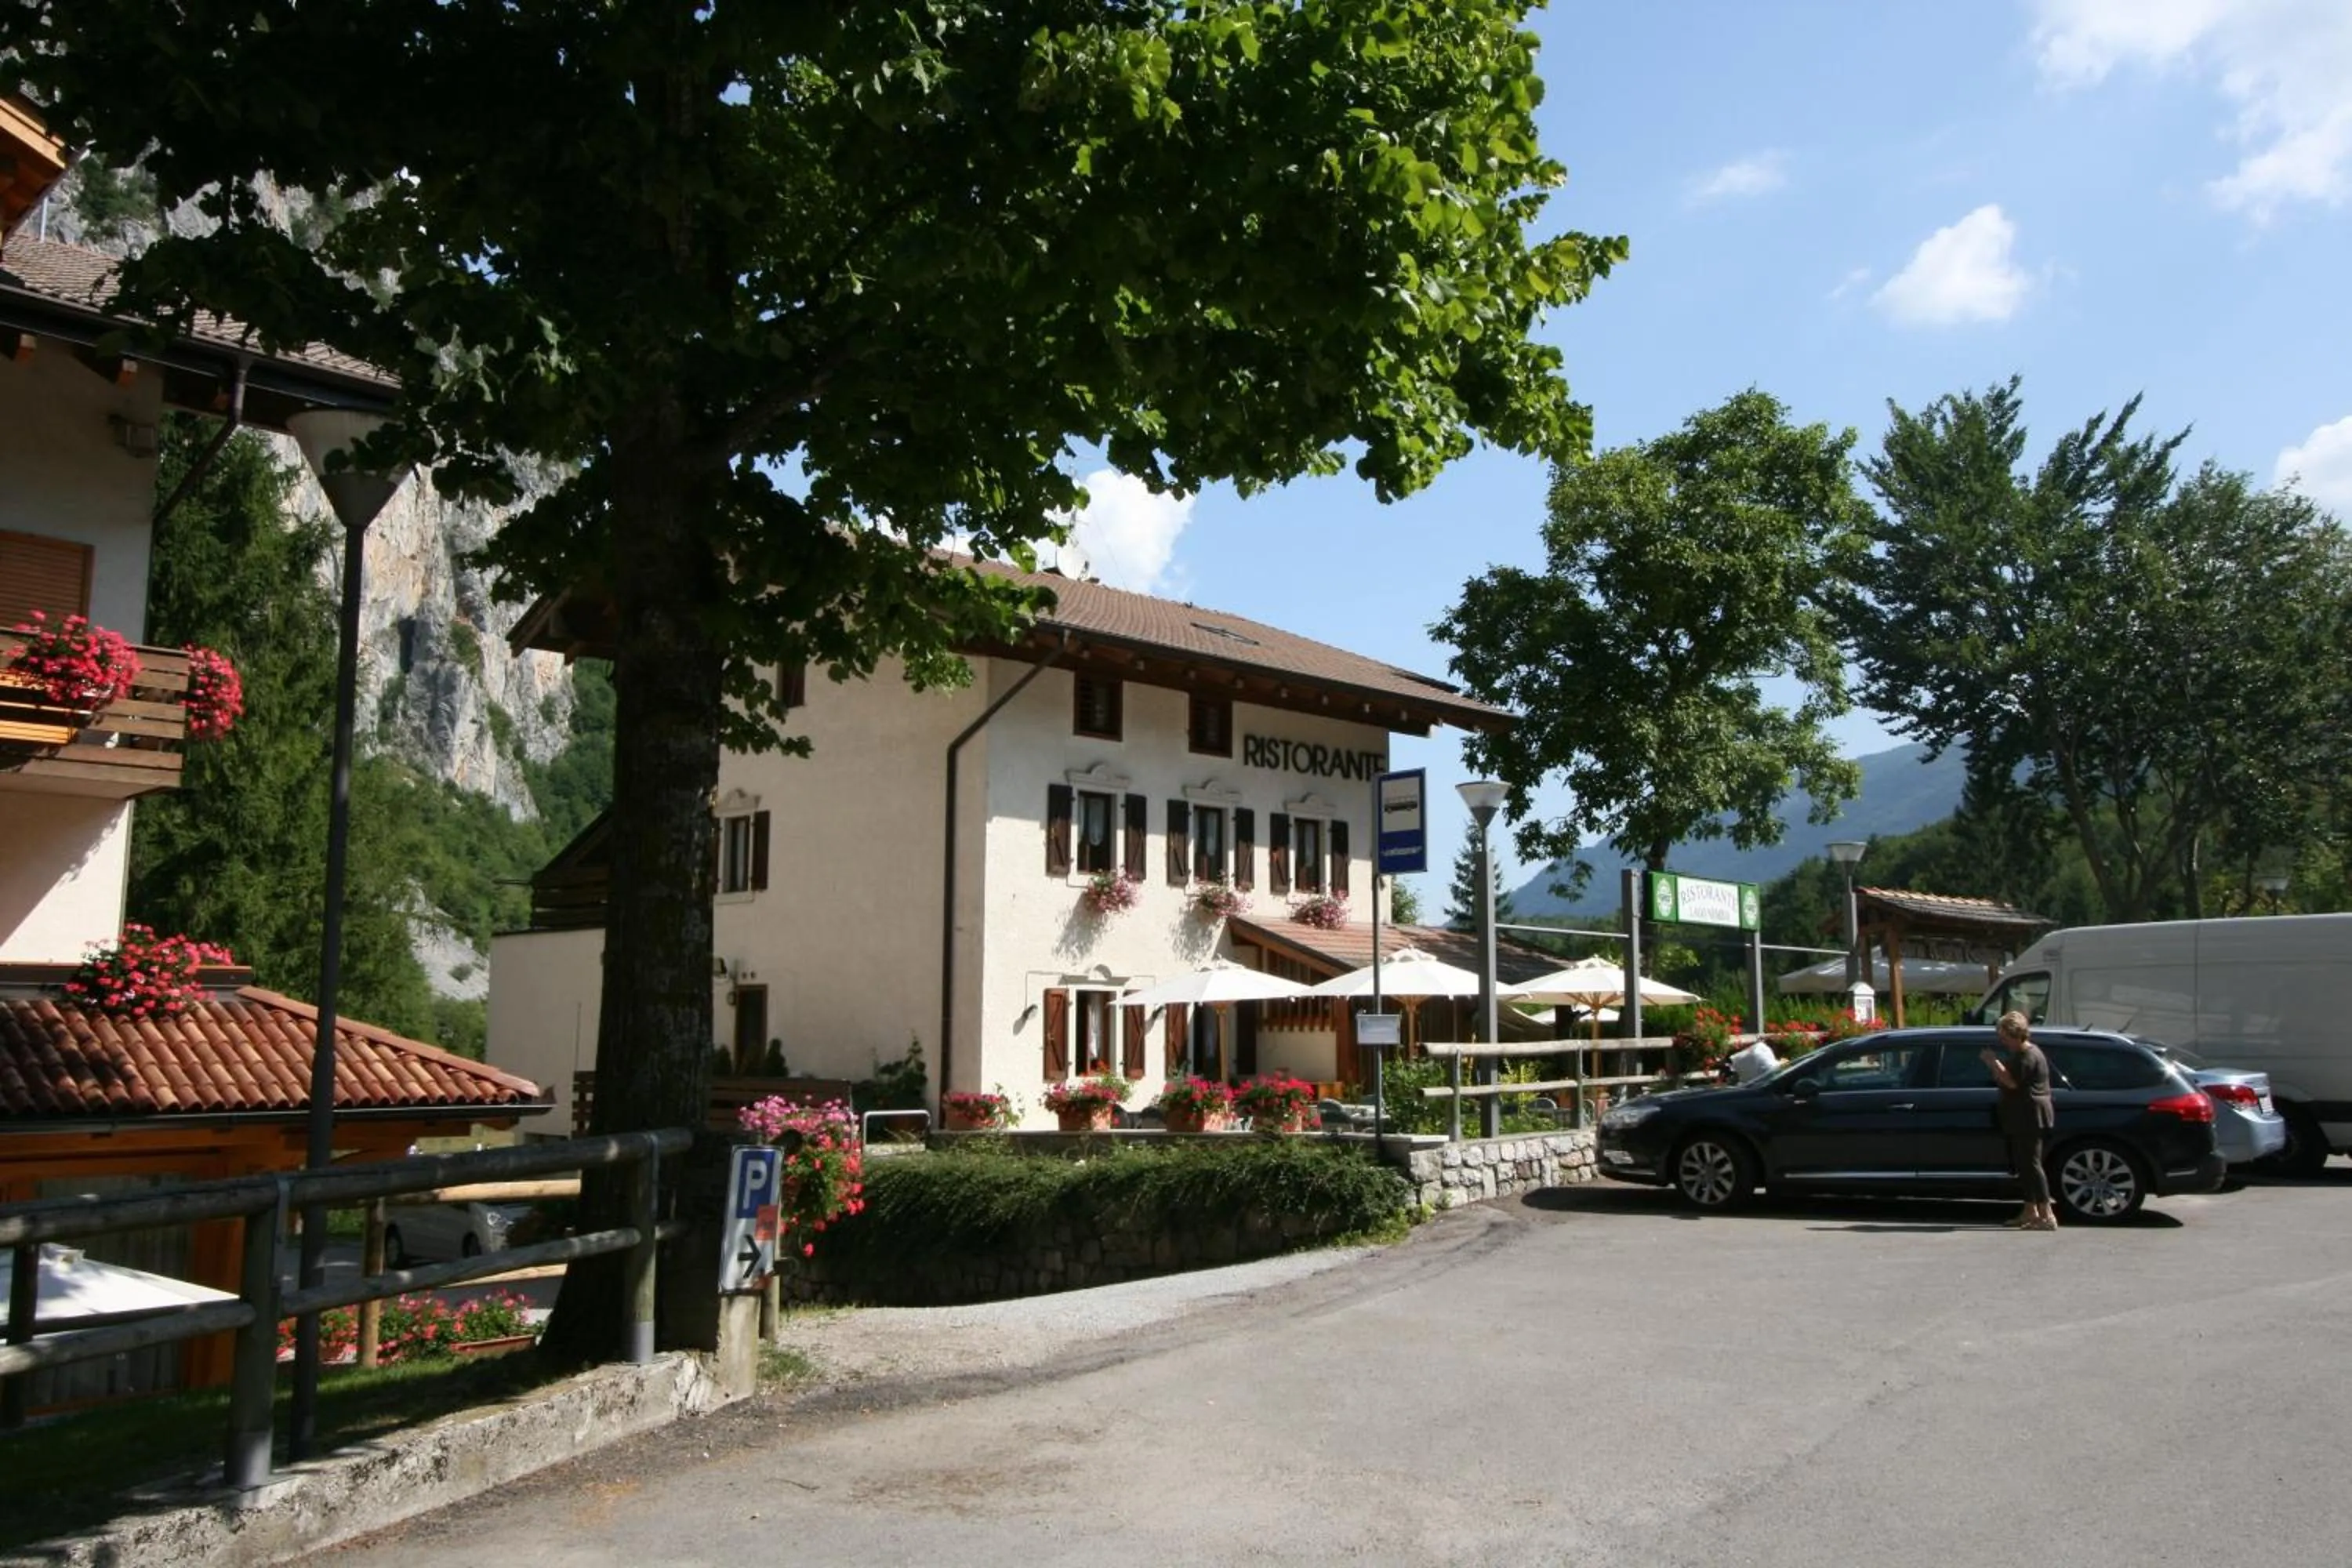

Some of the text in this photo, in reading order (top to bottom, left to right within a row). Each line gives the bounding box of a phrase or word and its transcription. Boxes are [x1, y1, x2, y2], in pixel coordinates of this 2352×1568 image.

[1243, 734, 1385, 782] RISTORANTE
[1680, 885, 1736, 912] RISTORANTE
[742, 1159, 768, 1210] P
